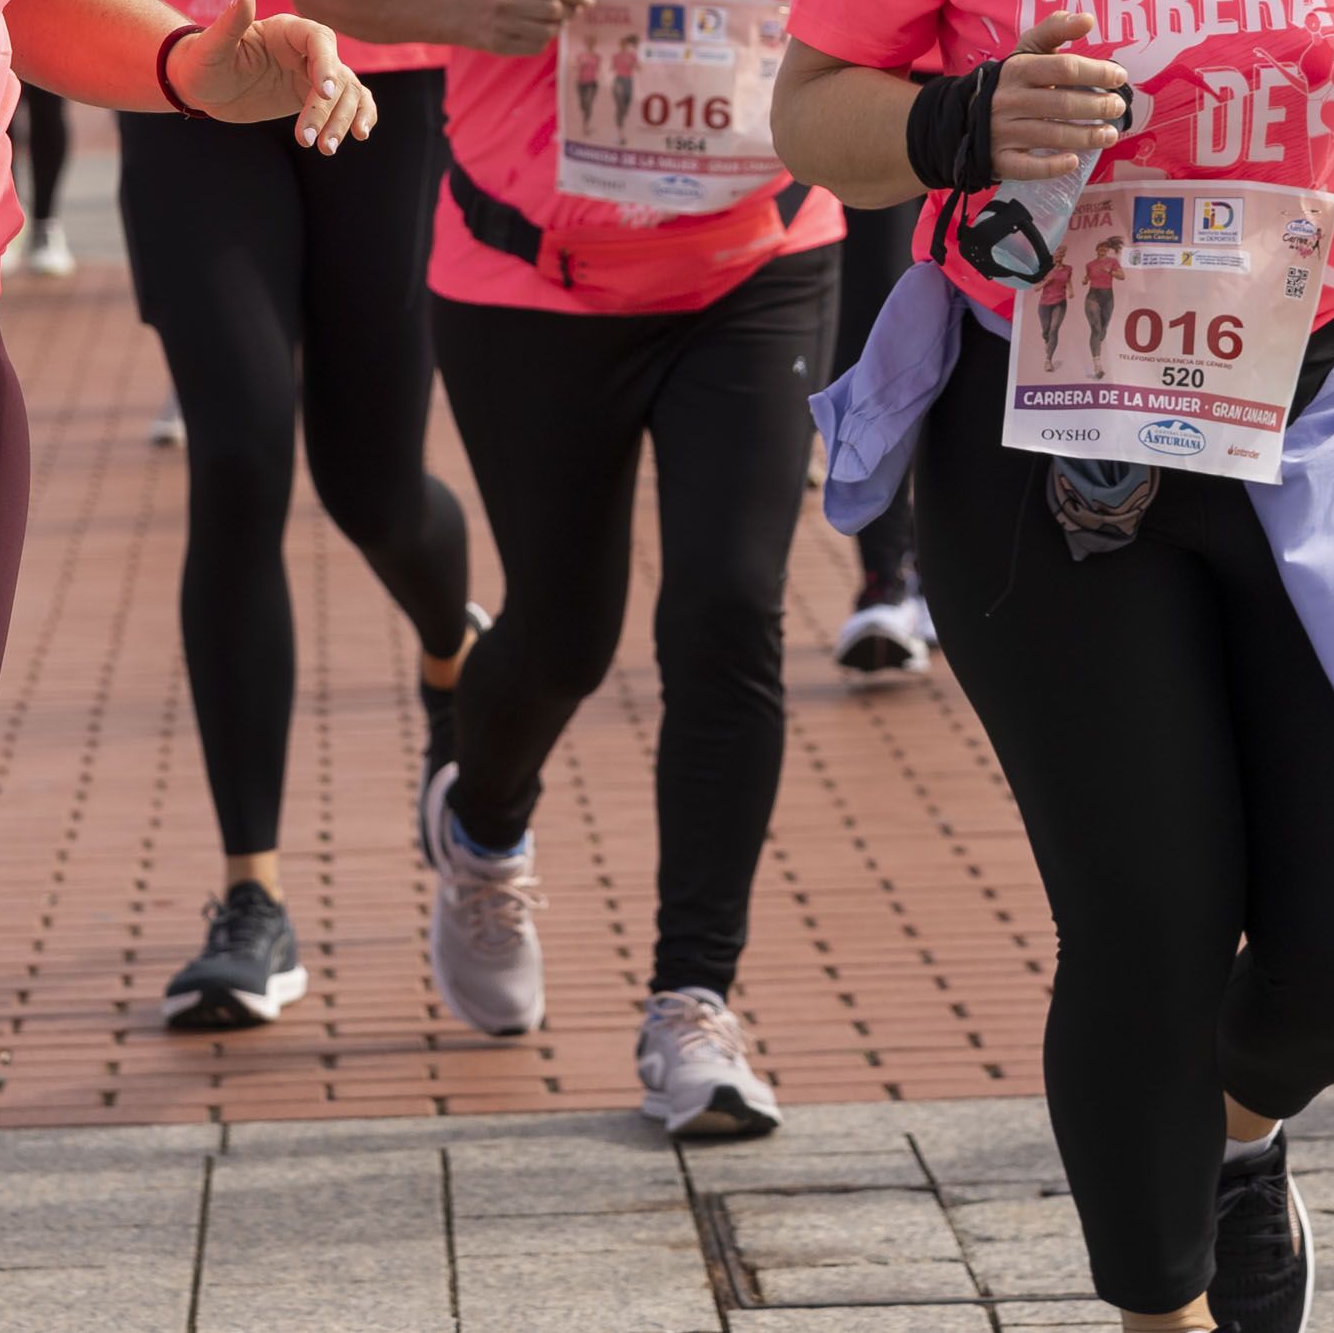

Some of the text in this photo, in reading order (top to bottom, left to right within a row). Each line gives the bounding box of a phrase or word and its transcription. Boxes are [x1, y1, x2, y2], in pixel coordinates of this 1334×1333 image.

[641, 93, 732, 131] 016
[1190, 61, 1300, 167] DE
[1124, 308, 1244, 360] 016
[1156, 357, 1195, 365] VIOLENCIA
[1161, 366, 1205, 388] 520
[1024, 390, 1277, 427] CARRERA DE LA MUJER GRAN CANARIA
[1041, 428, 1101, 442] OYSHO
[1144, 429, 1201, 450] ASTURIANA
[1233, 446, 1260, 459] Santander
